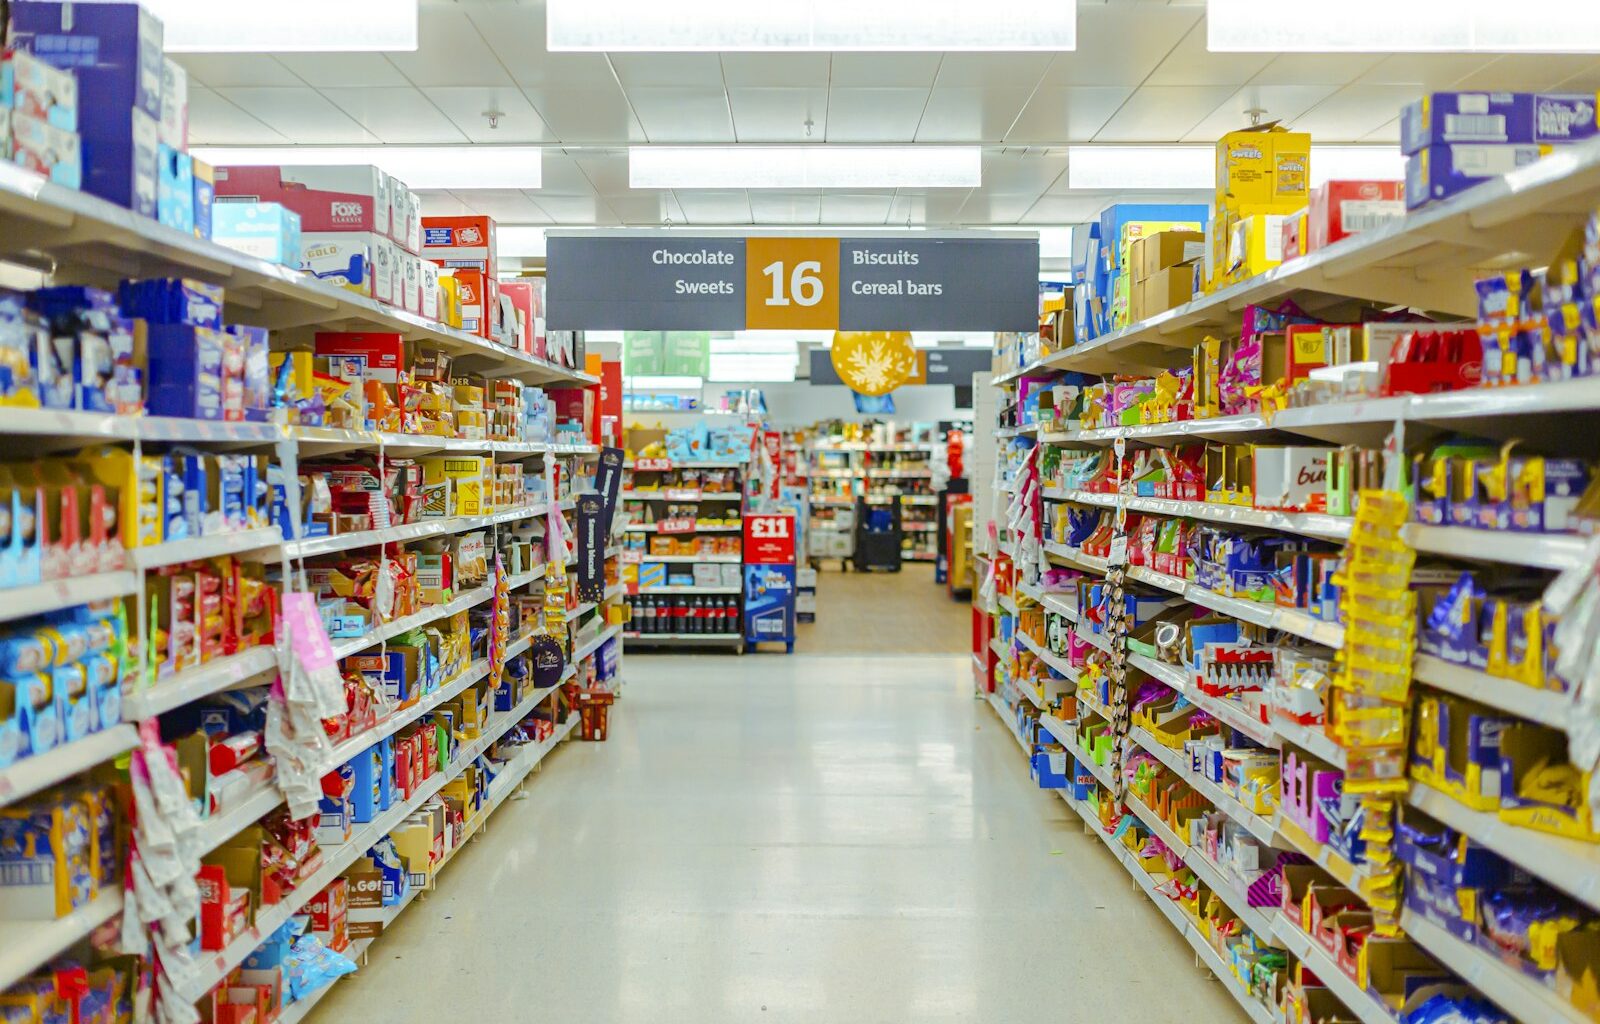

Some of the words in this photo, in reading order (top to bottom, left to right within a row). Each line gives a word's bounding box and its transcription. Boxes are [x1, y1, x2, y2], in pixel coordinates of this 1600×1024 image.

[652, 249, 735, 265] Chocolate
[852, 249, 919, 265] Biscuits
[675, 279, 735, 295] Sweets
[762, 260, 824, 307] 16
[851, 279, 903, 295] Cereal
[906, 279, 943, 295] bars
[587, 518, 596, 549] Savoury
[751, 517, 790, 538] £11
[588, 549, 596, 580] biscuits
[357, 880, 382, 892] GO!
